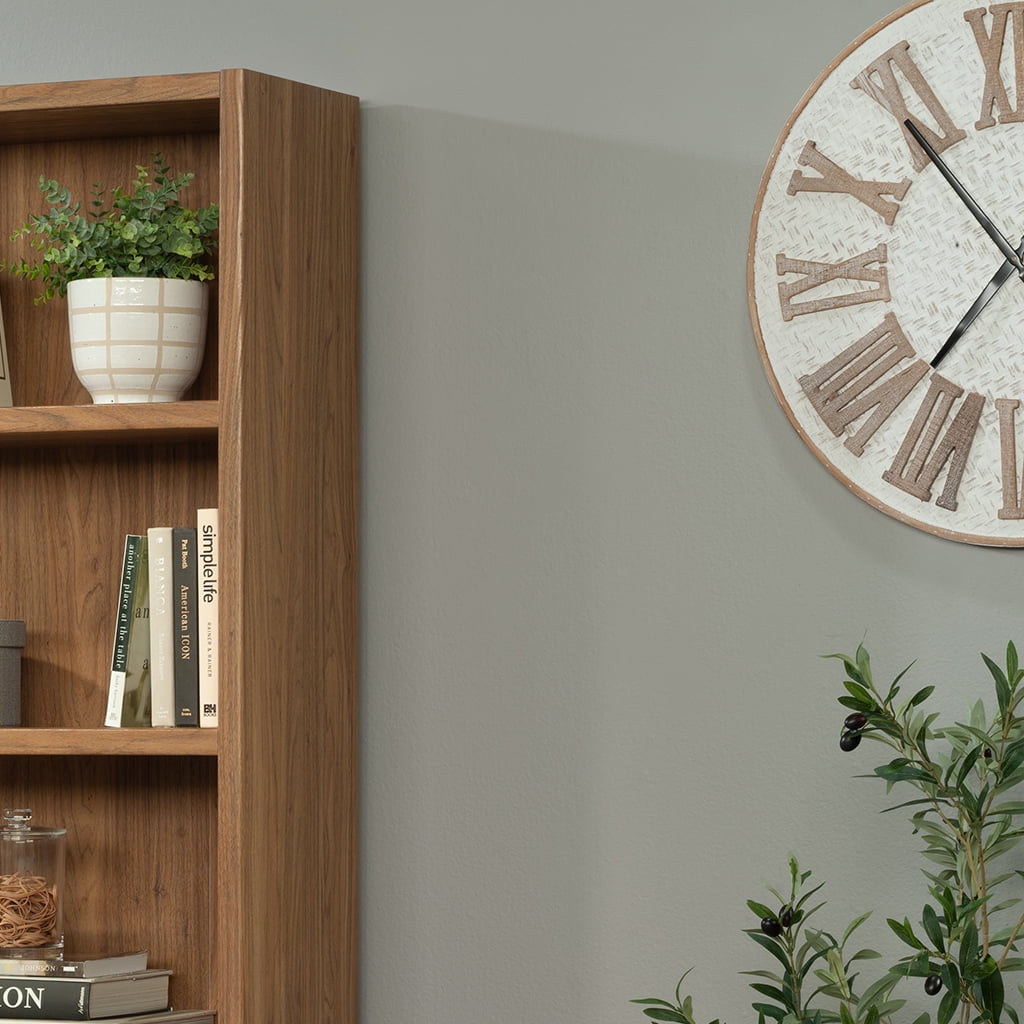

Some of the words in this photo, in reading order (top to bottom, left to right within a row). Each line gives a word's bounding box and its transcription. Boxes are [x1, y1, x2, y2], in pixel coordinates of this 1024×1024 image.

[180, 539, 189, 551] Pat
[125, 543, 135, 582] another
[180, 551, 188, 570] Booth
[121, 583, 133, 610] place
[180, 584, 190, 631] American
[120, 613, 129, 623] at
[118, 626, 127, 641] the
[115, 645, 125, 669] table
[181, 634, 190, 660] ICON
